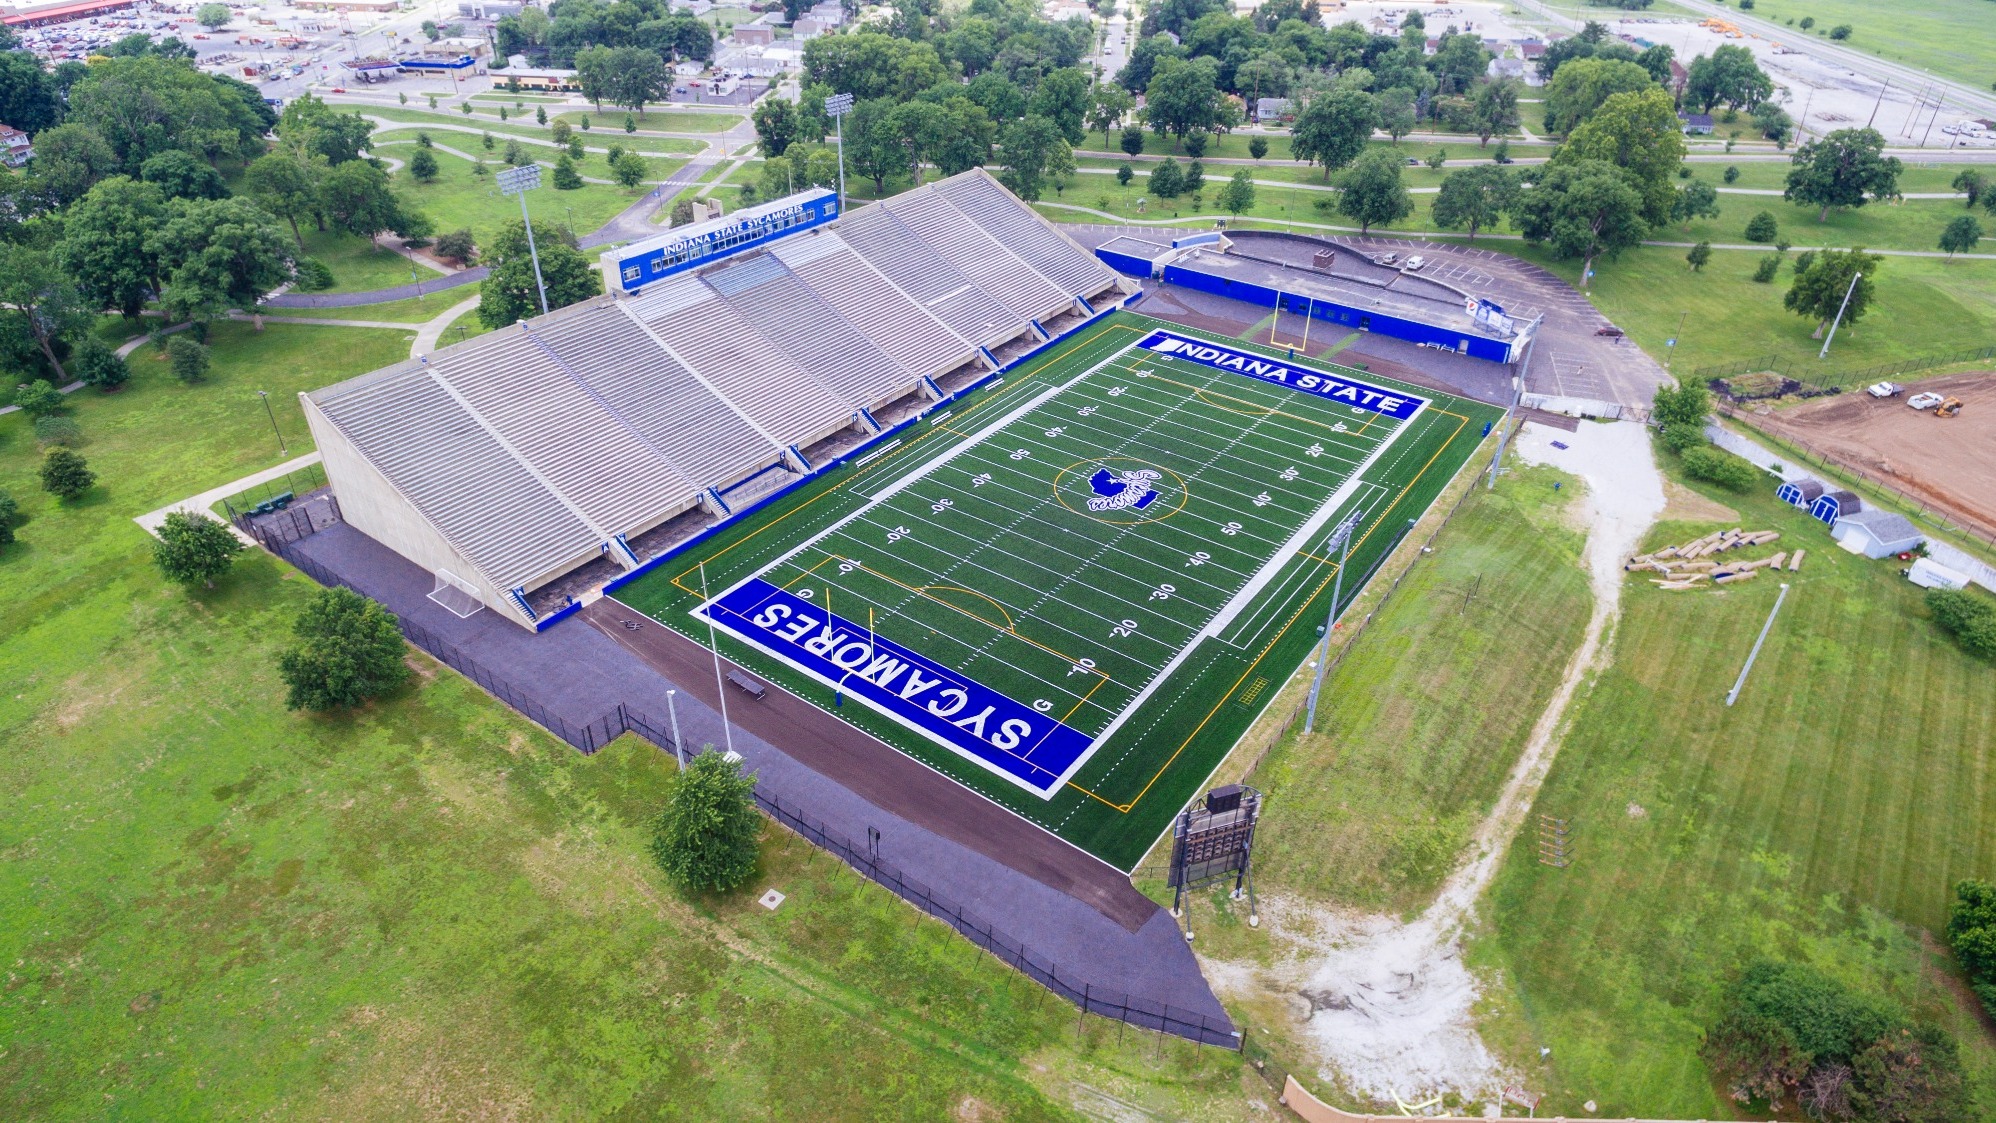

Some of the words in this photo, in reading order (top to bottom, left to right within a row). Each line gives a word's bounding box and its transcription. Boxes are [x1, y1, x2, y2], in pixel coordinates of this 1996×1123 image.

[664, 236, 711, 255] INDIANA
[714, 224, 743, 239] STATE
[747, 205, 803, 229] SYCAMORES
[1296, 375, 1406, 413] STATE
[1010, 448, 1031, 460] 50
[1305, 444, 1324, 457] 20
[972, 472, 992, 485] 40
[1280, 468, 1299, 481] 30
[931, 498, 954, 511] 30
[1252, 494, 1272, 507] 40
[887, 525, 911, 540] 20
[1220, 521, 1243, 536] 50
[838, 558, 862, 572] 10
[1189, 551, 1211, 567] 40
[796, 588, 814, 599] G
[1152, 583, 1176, 600] 30
[1113, 619, 1138, 638] 20
[1072, 657, 1096, 674] 10
[753, 603, 1032, 751] SYCAMORES
[1033, 698, 1054, 712] G
